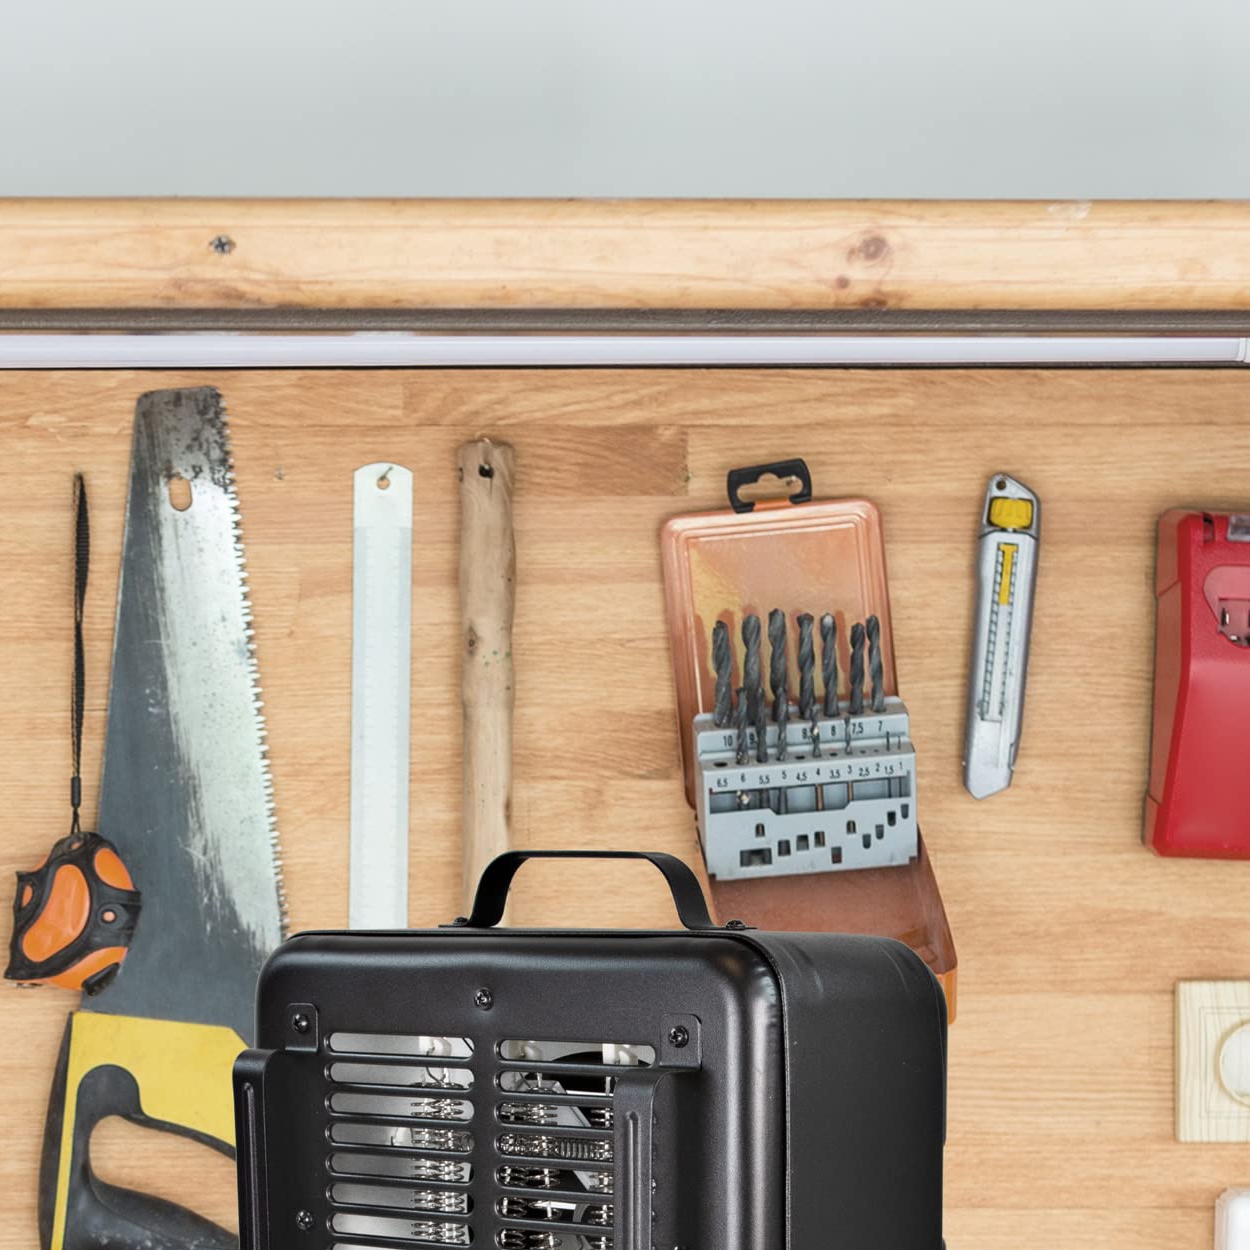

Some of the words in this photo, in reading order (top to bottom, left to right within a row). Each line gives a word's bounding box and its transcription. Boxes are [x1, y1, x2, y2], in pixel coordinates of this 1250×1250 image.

[723, 734, 733, 747] 10
[830, 724, 836, 736] 8
[851, 722, 864, 735] 7,5
[878, 720, 883, 732] 7
[716, 777, 728, 787] 6,5
[740, 773, 746, 783] 6
[758, 775, 770, 785] 5,5
[781, 770, 787, 780] 5
[796, 771, 807, 782] 4,5
[815, 767, 821, 776] 4
[829, 769, 841, 779] 3,5
[847, 764, 852, 774] 3
[858, 766, 870, 777] 2,5
[875, 762, 880, 772] 2
[884, 765, 894, 775] 1,5
